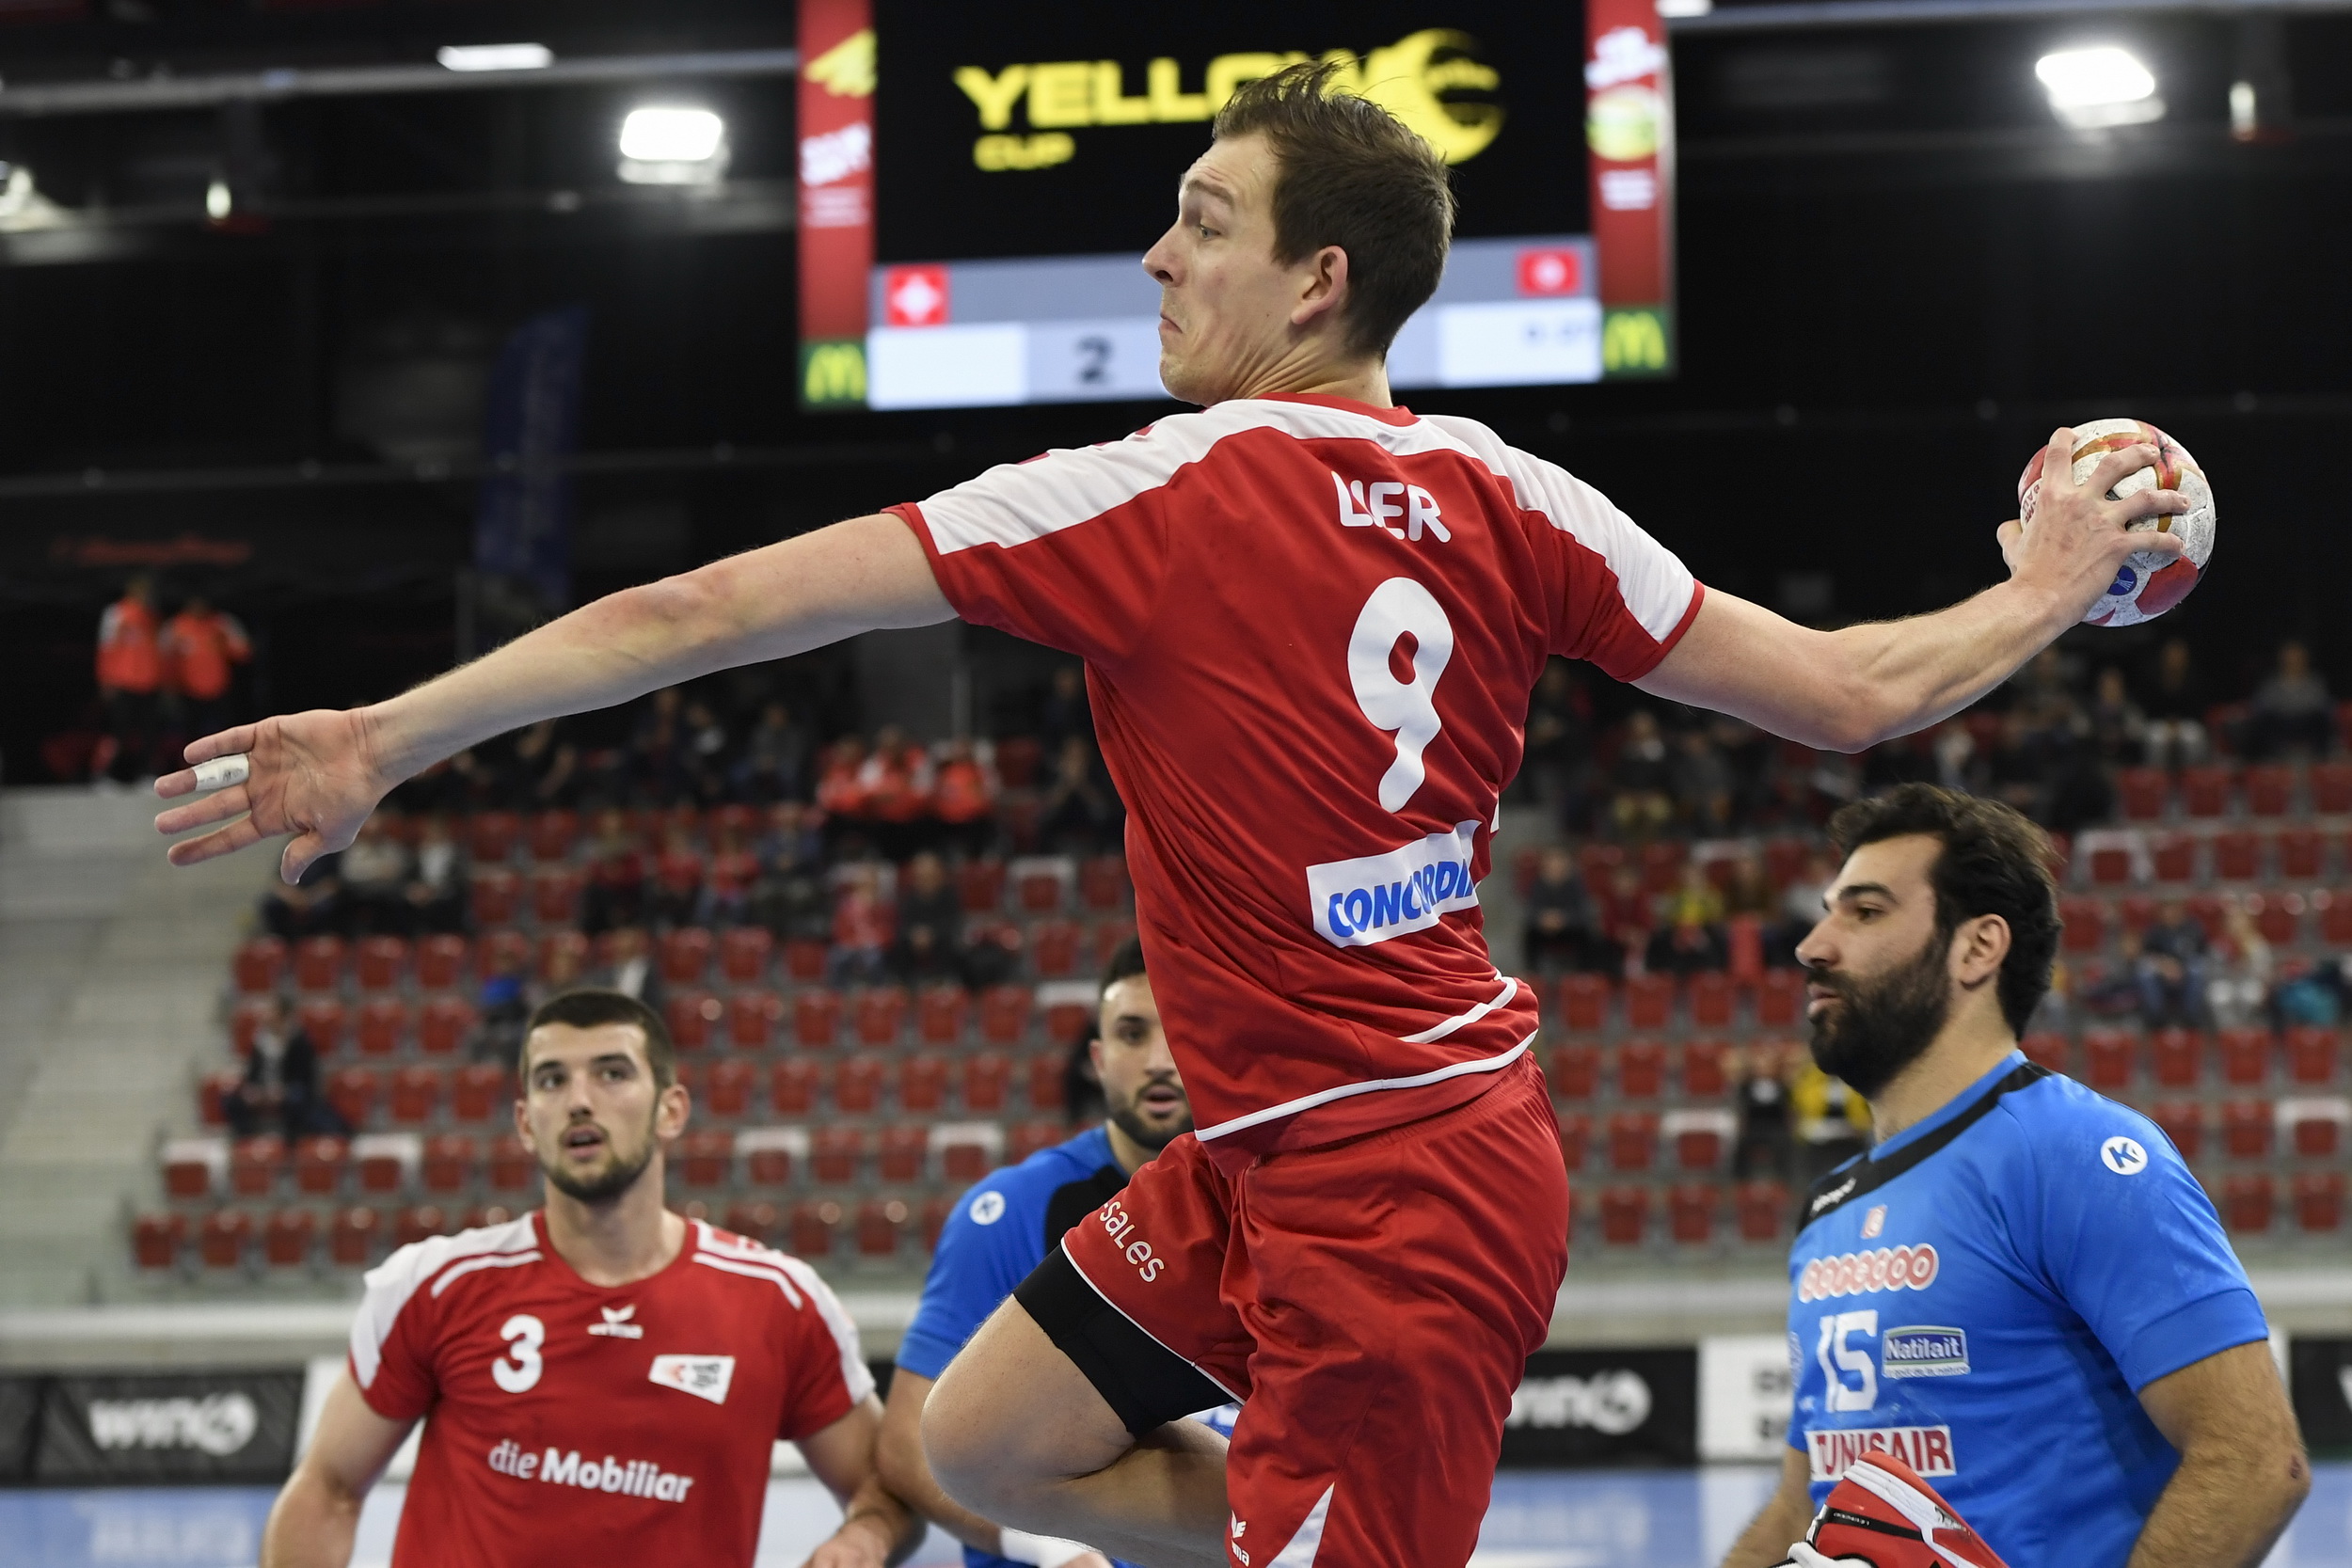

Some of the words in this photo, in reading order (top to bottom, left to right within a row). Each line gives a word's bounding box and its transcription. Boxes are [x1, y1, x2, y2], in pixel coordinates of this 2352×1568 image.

[1075, 336, 1113, 384] 2
[1347, 577, 1454, 814] 9
[491, 1313, 546, 1394] 3
[1816, 1308, 1879, 1414] 15
[1886, 1336, 1962, 1363] Natilait
[487, 1438, 538, 1480] die
[539, 1447, 694, 1504] Mobiliar
[1814, 1429, 1952, 1476] TUNISAIR
